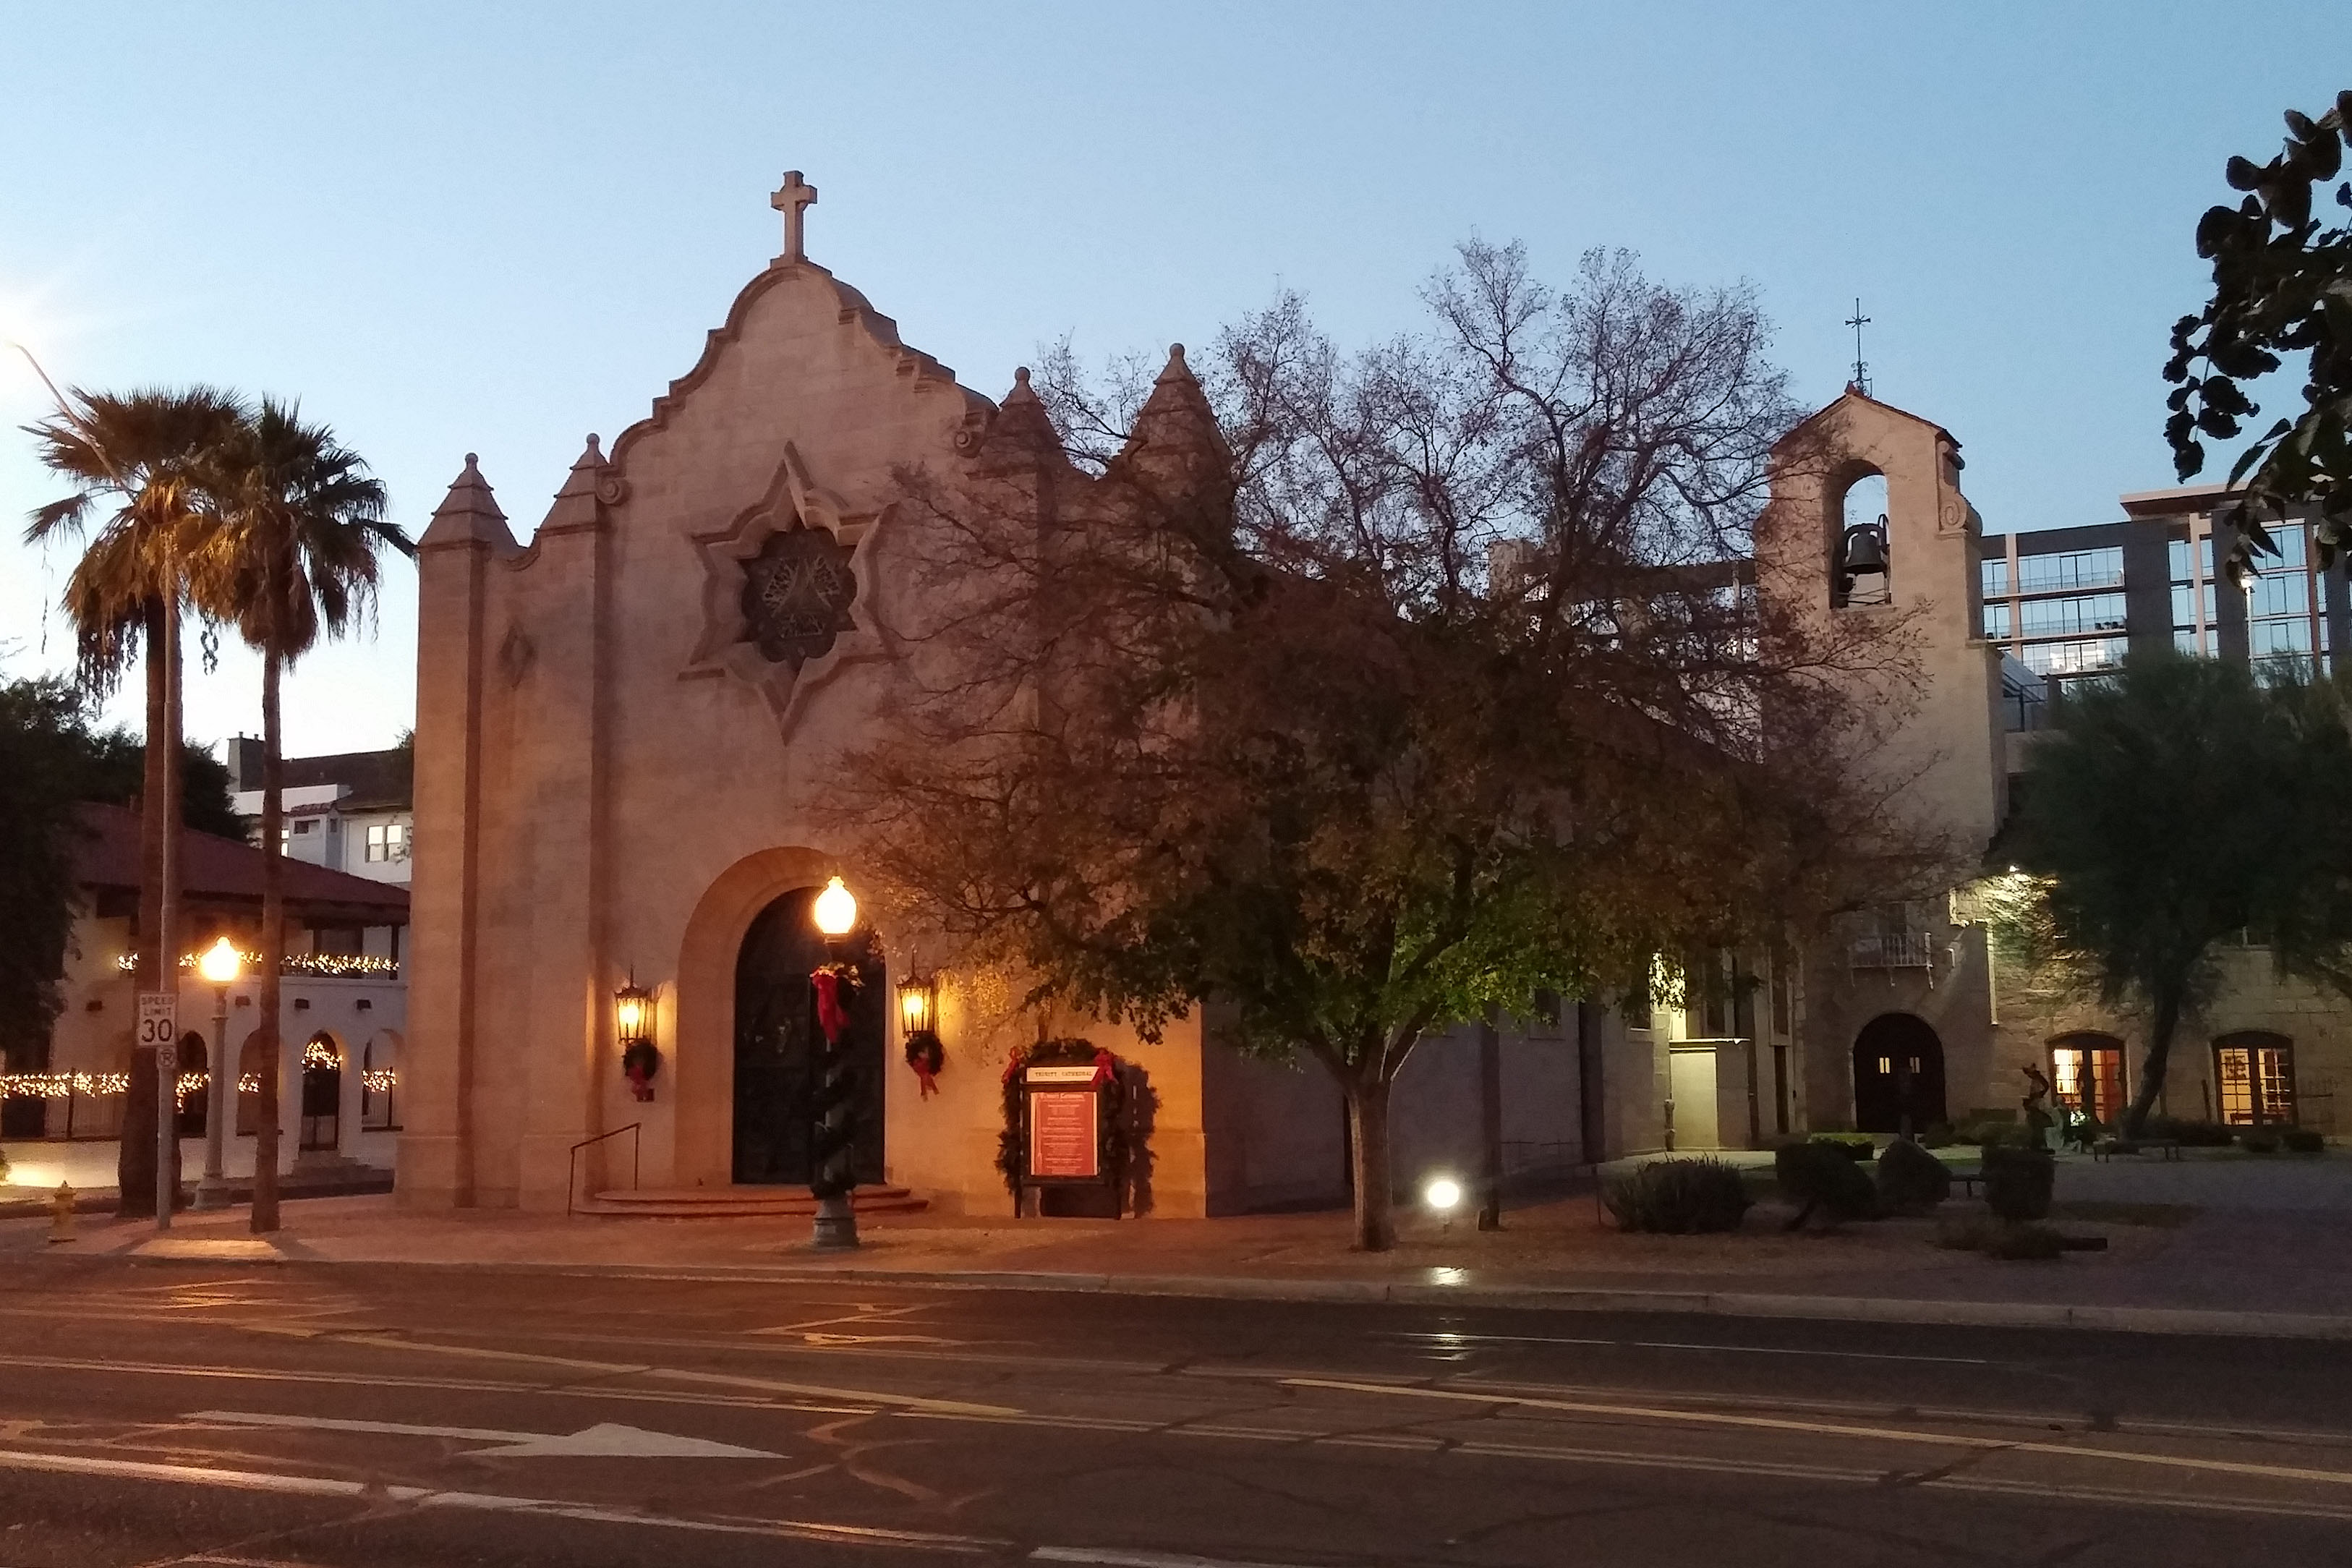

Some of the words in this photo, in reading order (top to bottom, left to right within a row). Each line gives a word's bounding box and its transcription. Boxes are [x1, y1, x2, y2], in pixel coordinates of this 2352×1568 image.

[141, 997, 174, 1005] SPEED
[143, 1007, 171, 1016] LIMIT
[142, 1018, 172, 1042] 30
